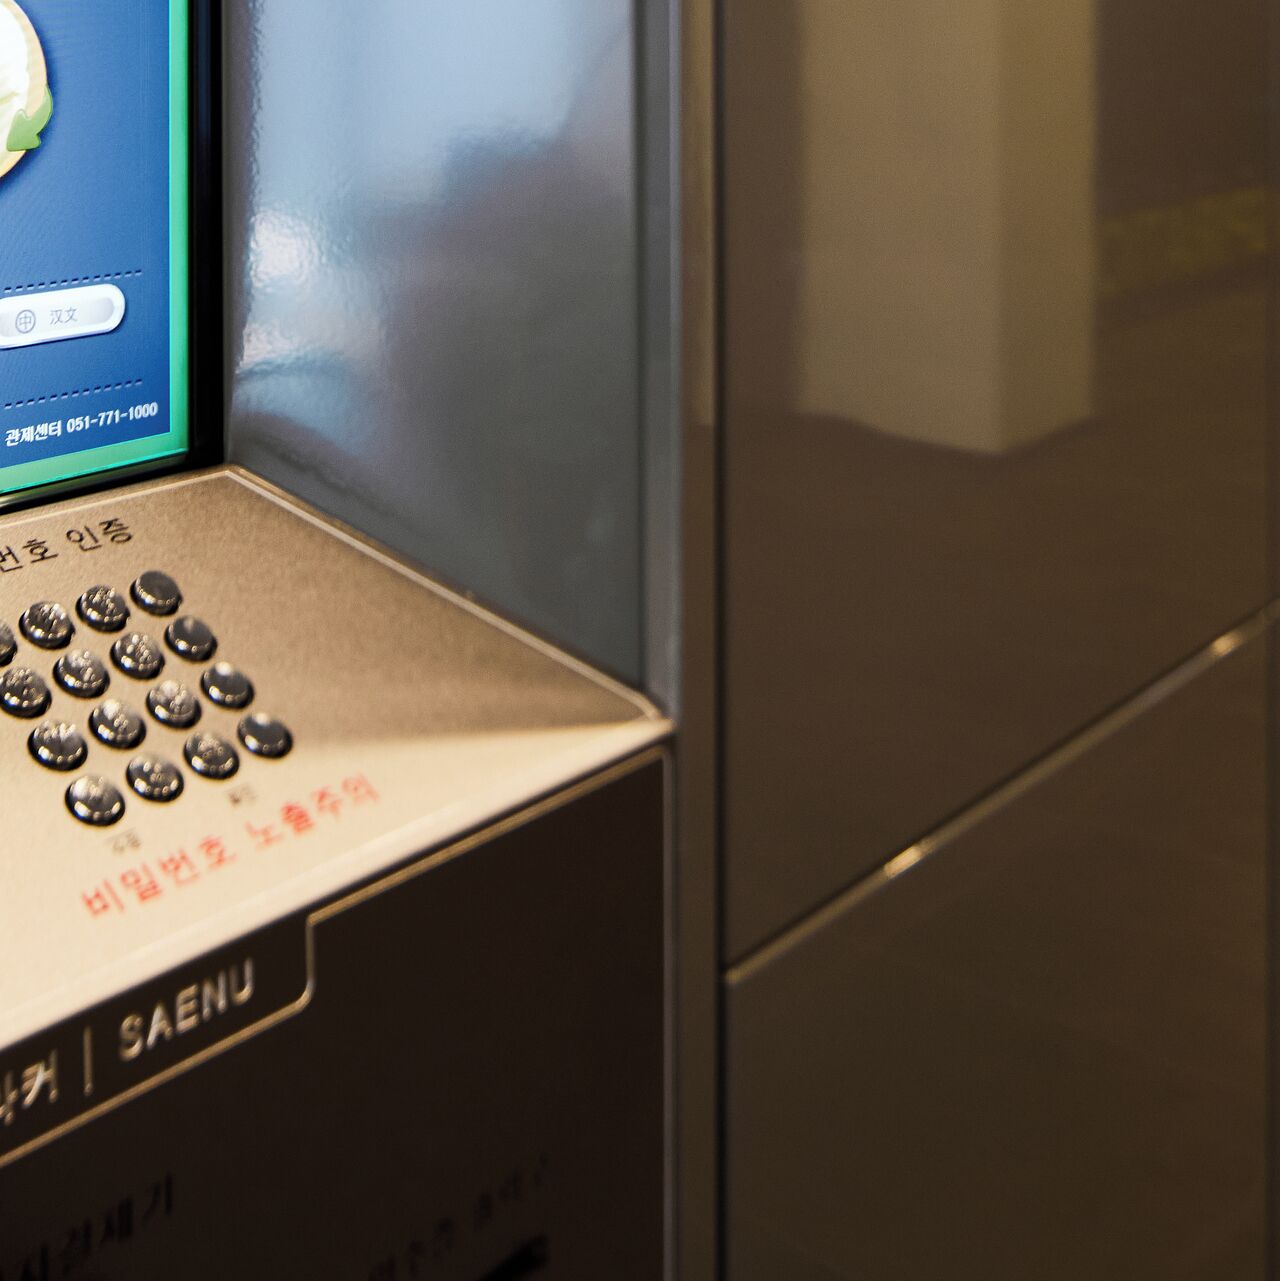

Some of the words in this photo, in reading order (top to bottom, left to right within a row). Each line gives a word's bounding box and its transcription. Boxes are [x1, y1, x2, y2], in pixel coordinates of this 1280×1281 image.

[49, 306, 78, 325] 汉文
[5, 419, 62, 447] 관제센터
[66, 401, 159, 434] 051-771-1000
[66, 517, 134, 552] 인증
[80, 834, 236, 915] 비밀번호
[245, 773, 379, 849] 노출주의
[120, 957, 254, 1062] SAENU
